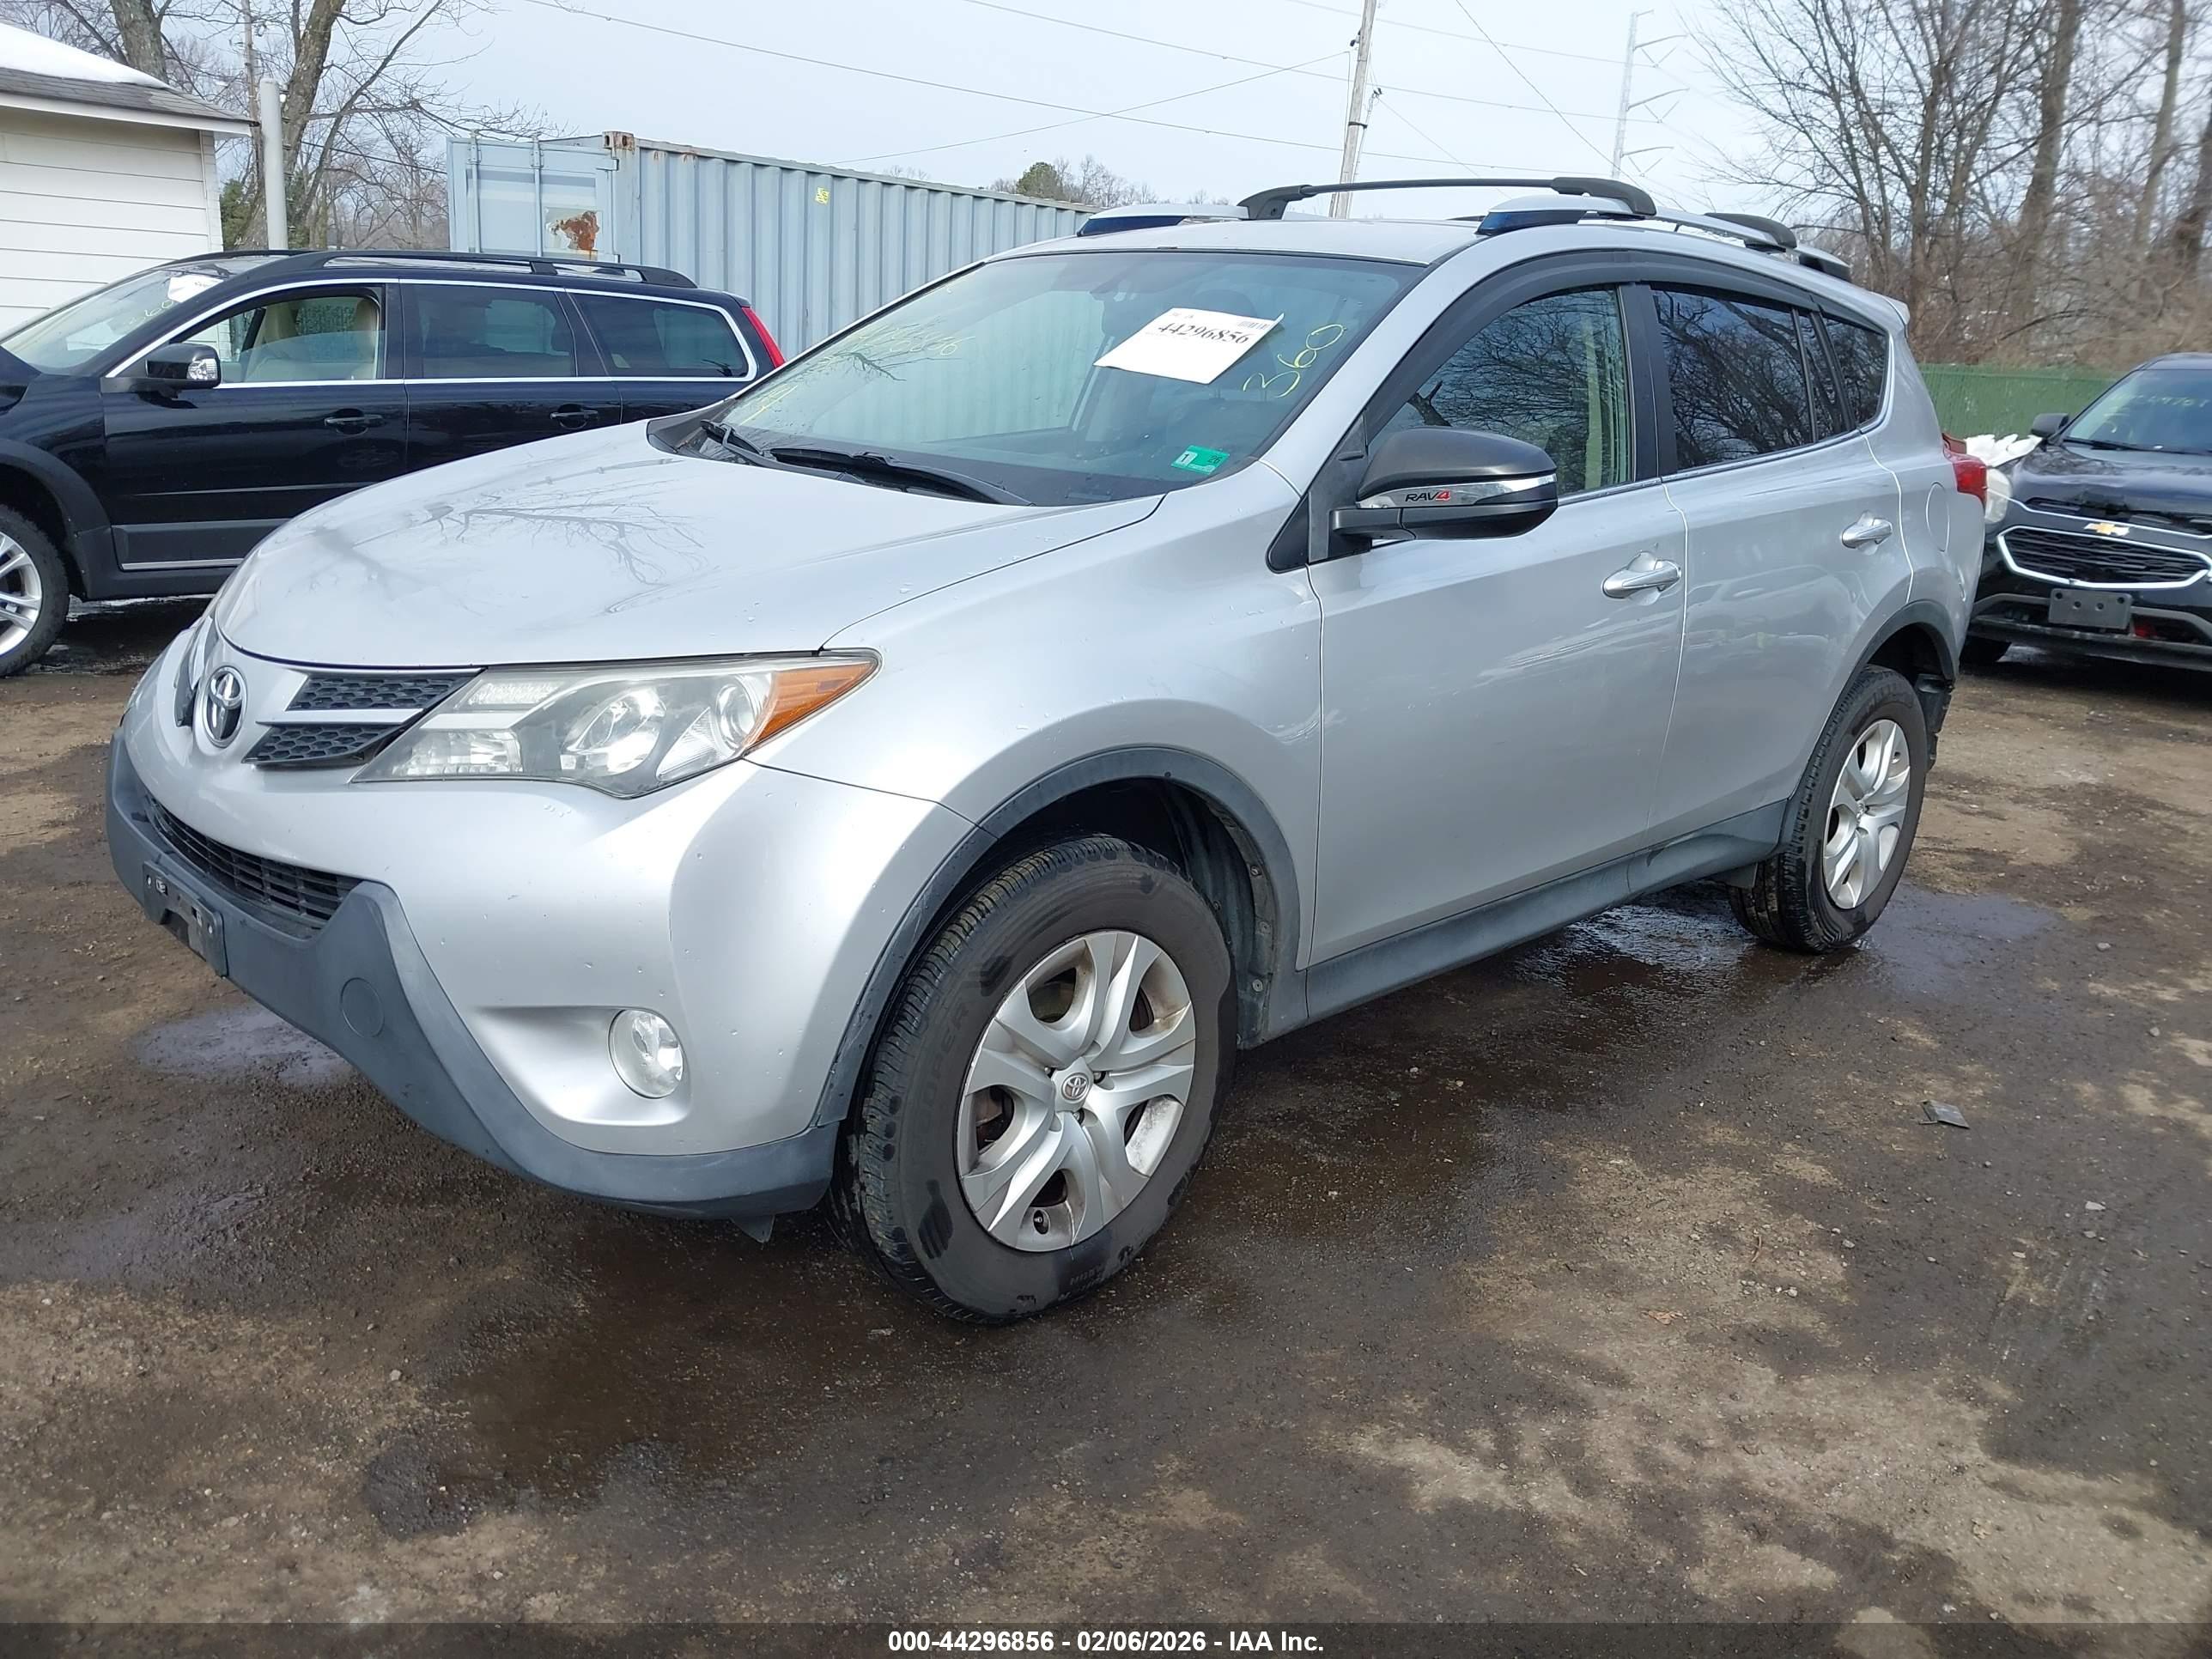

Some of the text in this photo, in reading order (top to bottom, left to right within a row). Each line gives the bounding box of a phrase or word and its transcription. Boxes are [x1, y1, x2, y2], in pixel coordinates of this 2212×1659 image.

[1158, 322, 1249, 344] 44296856
[1243, 324, 1346, 398] 360
[1207, 455, 1223, 464] 26
[1405, 489, 1451, 502] RAV4
